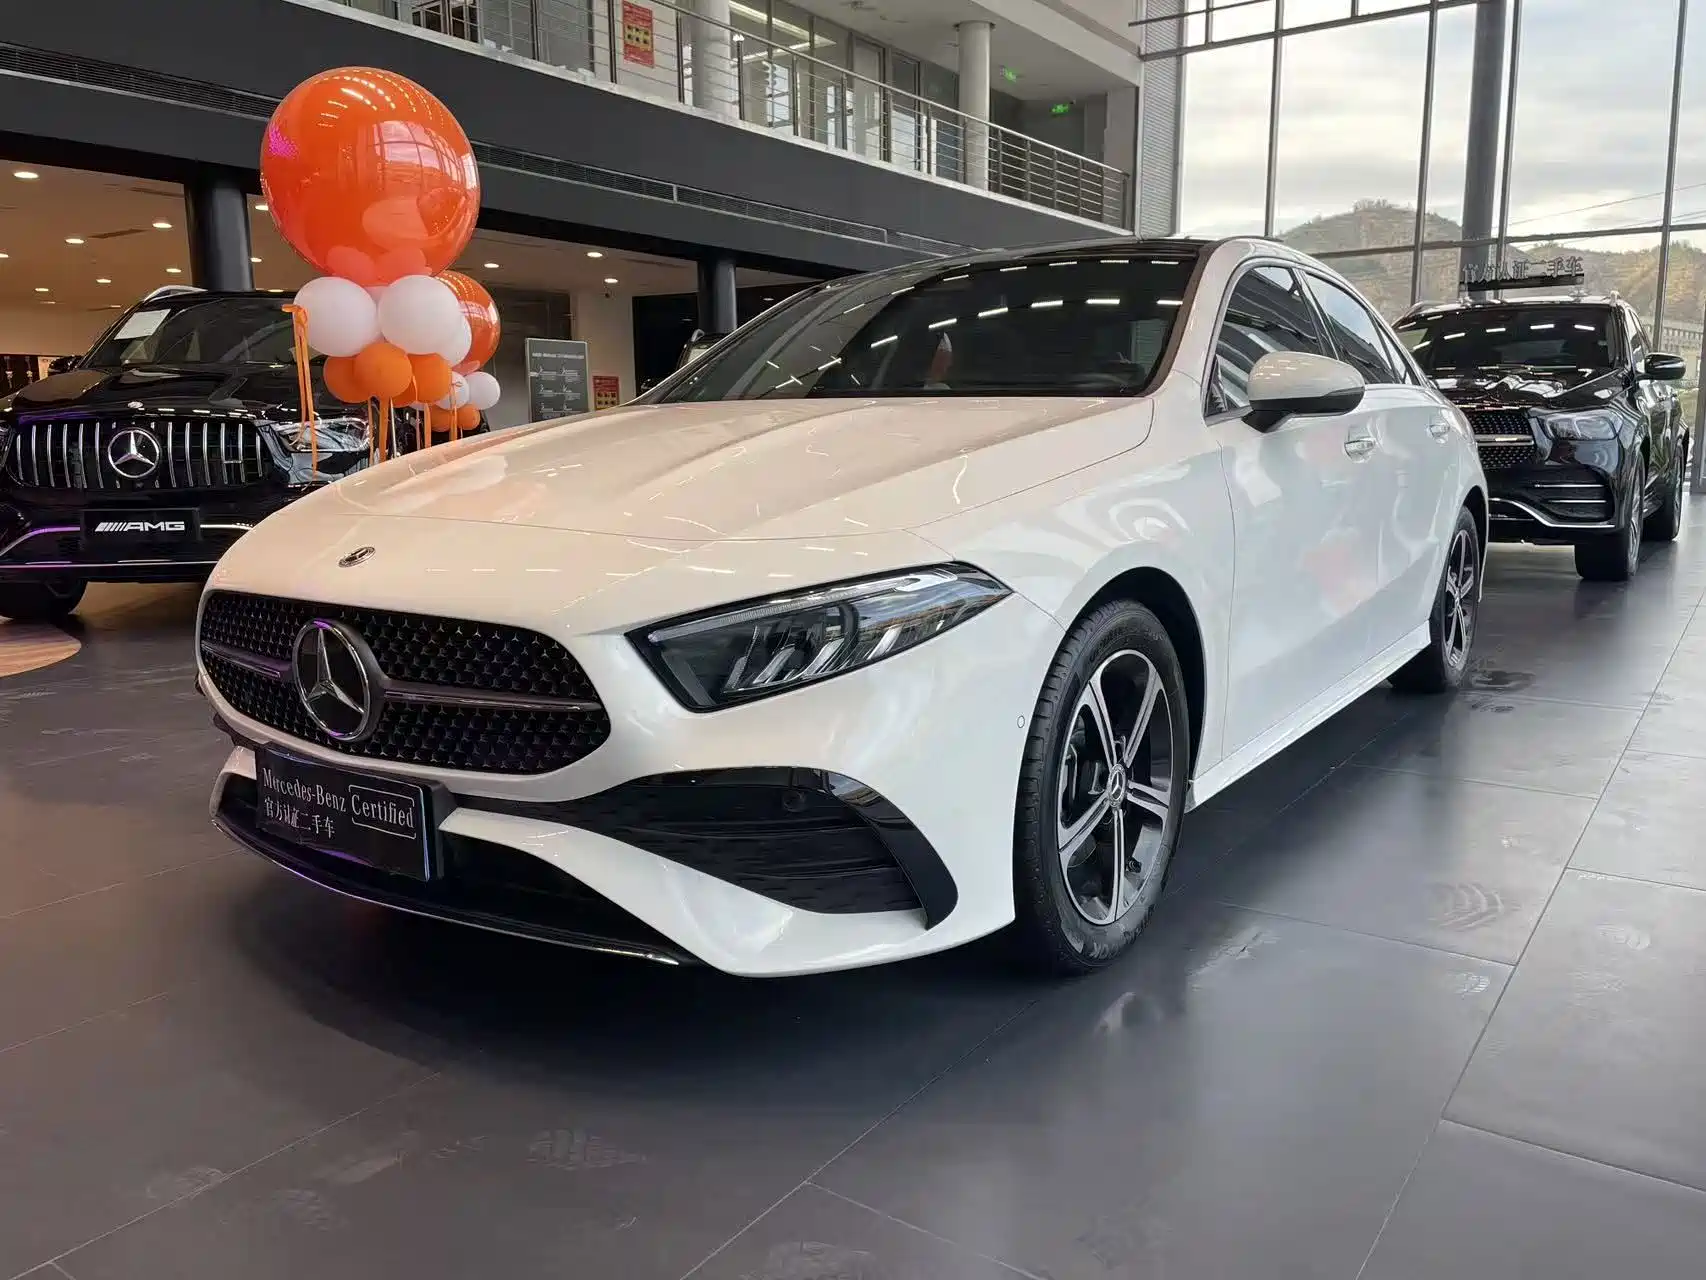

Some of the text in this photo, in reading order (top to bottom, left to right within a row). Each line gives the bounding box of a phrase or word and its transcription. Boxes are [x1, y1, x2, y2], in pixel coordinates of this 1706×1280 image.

[122, 521, 185, 532] AMG
[262, 767, 415, 829] Mercedes-Benz Certified
